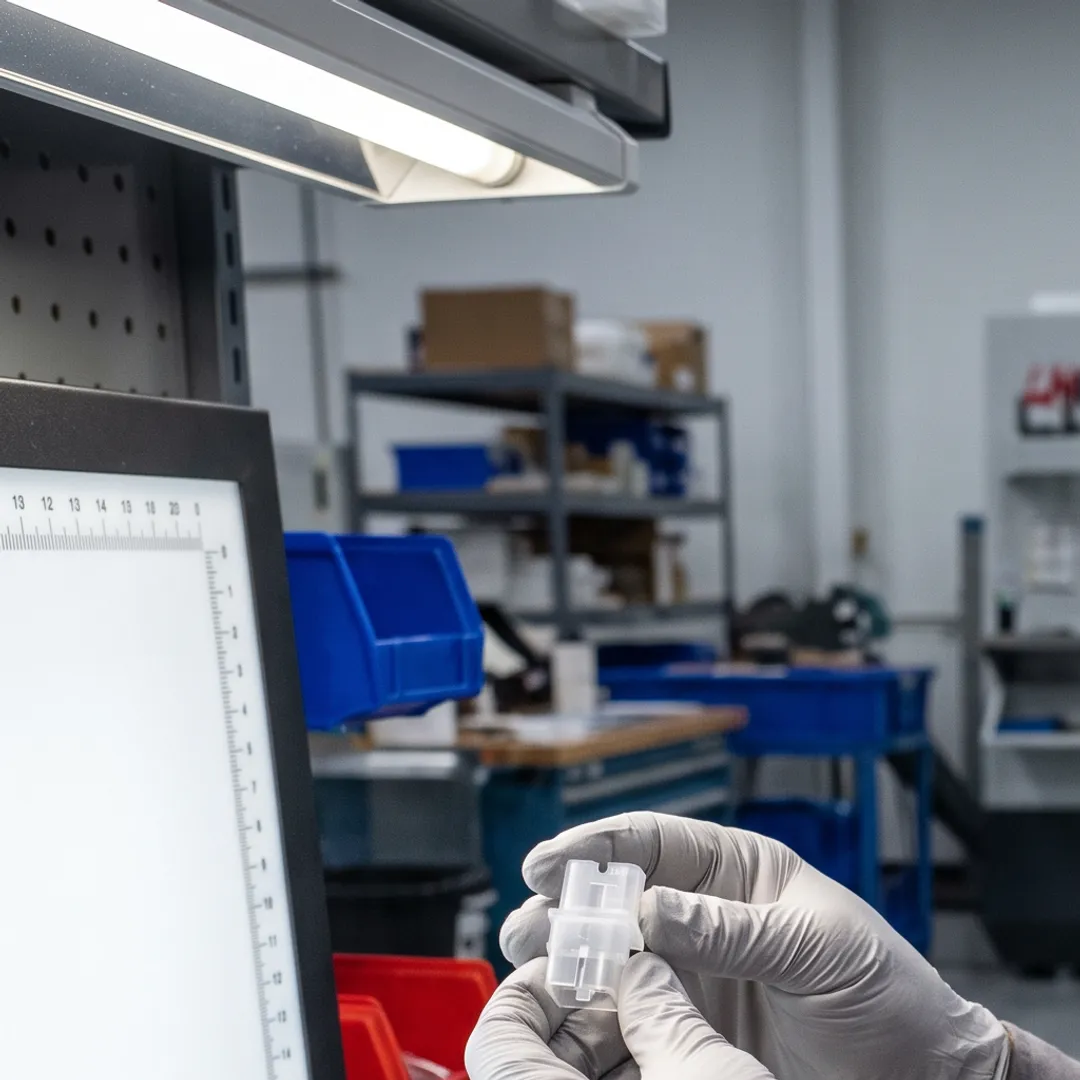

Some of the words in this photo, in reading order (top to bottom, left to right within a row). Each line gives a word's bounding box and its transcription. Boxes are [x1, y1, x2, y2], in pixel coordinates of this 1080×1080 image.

[12, 495, 25, 510] 13
[41, 496, 54, 511] 12
[69, 497, 81, 512] 13
[95, 498, 107, 513] 14
